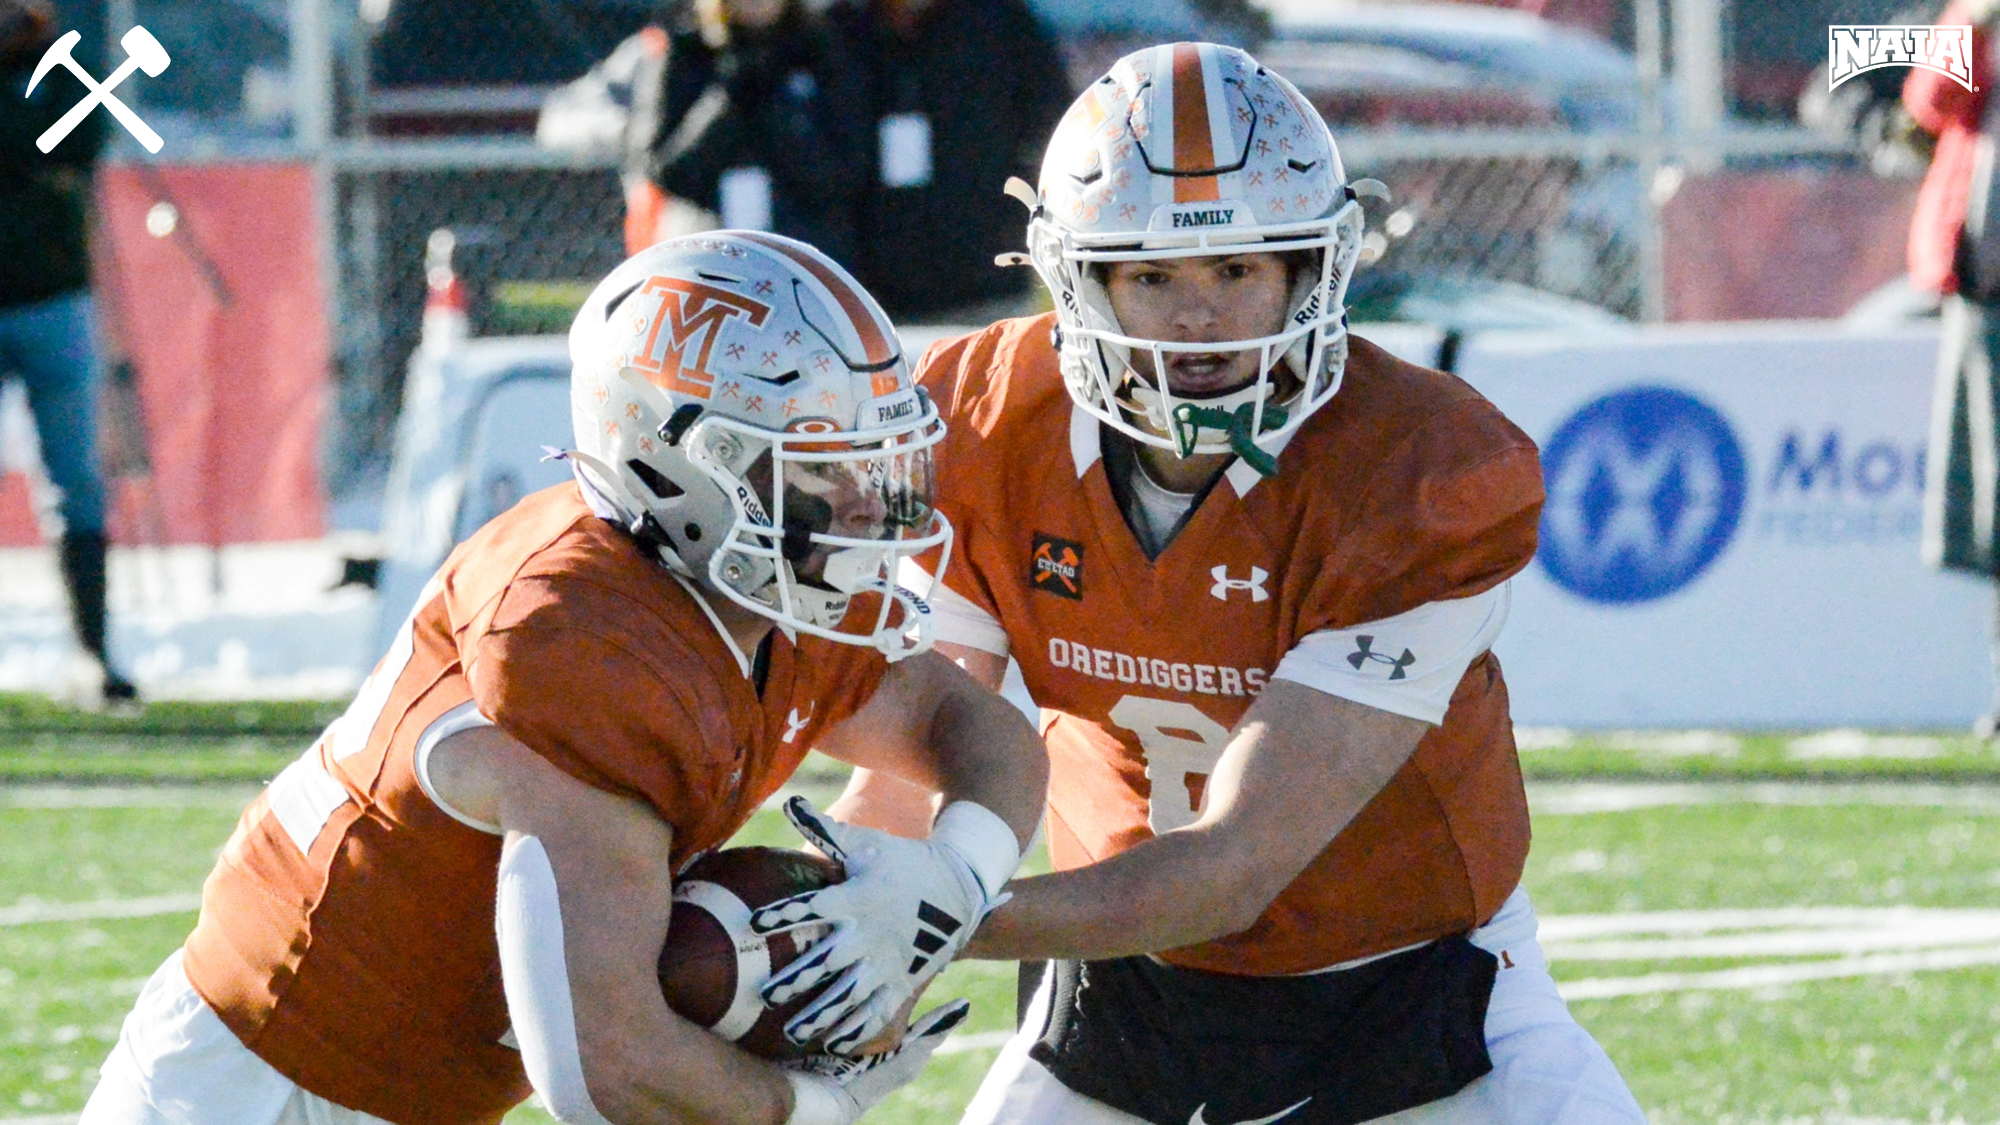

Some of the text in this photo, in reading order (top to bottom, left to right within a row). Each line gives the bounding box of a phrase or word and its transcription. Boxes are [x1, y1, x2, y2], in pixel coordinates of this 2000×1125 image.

[1172, 209, 1234, 228] FAMILY
[1294, 267, 1341, 325] Ridell
[1049, 637, 1268, 697] OREDIGGERS
